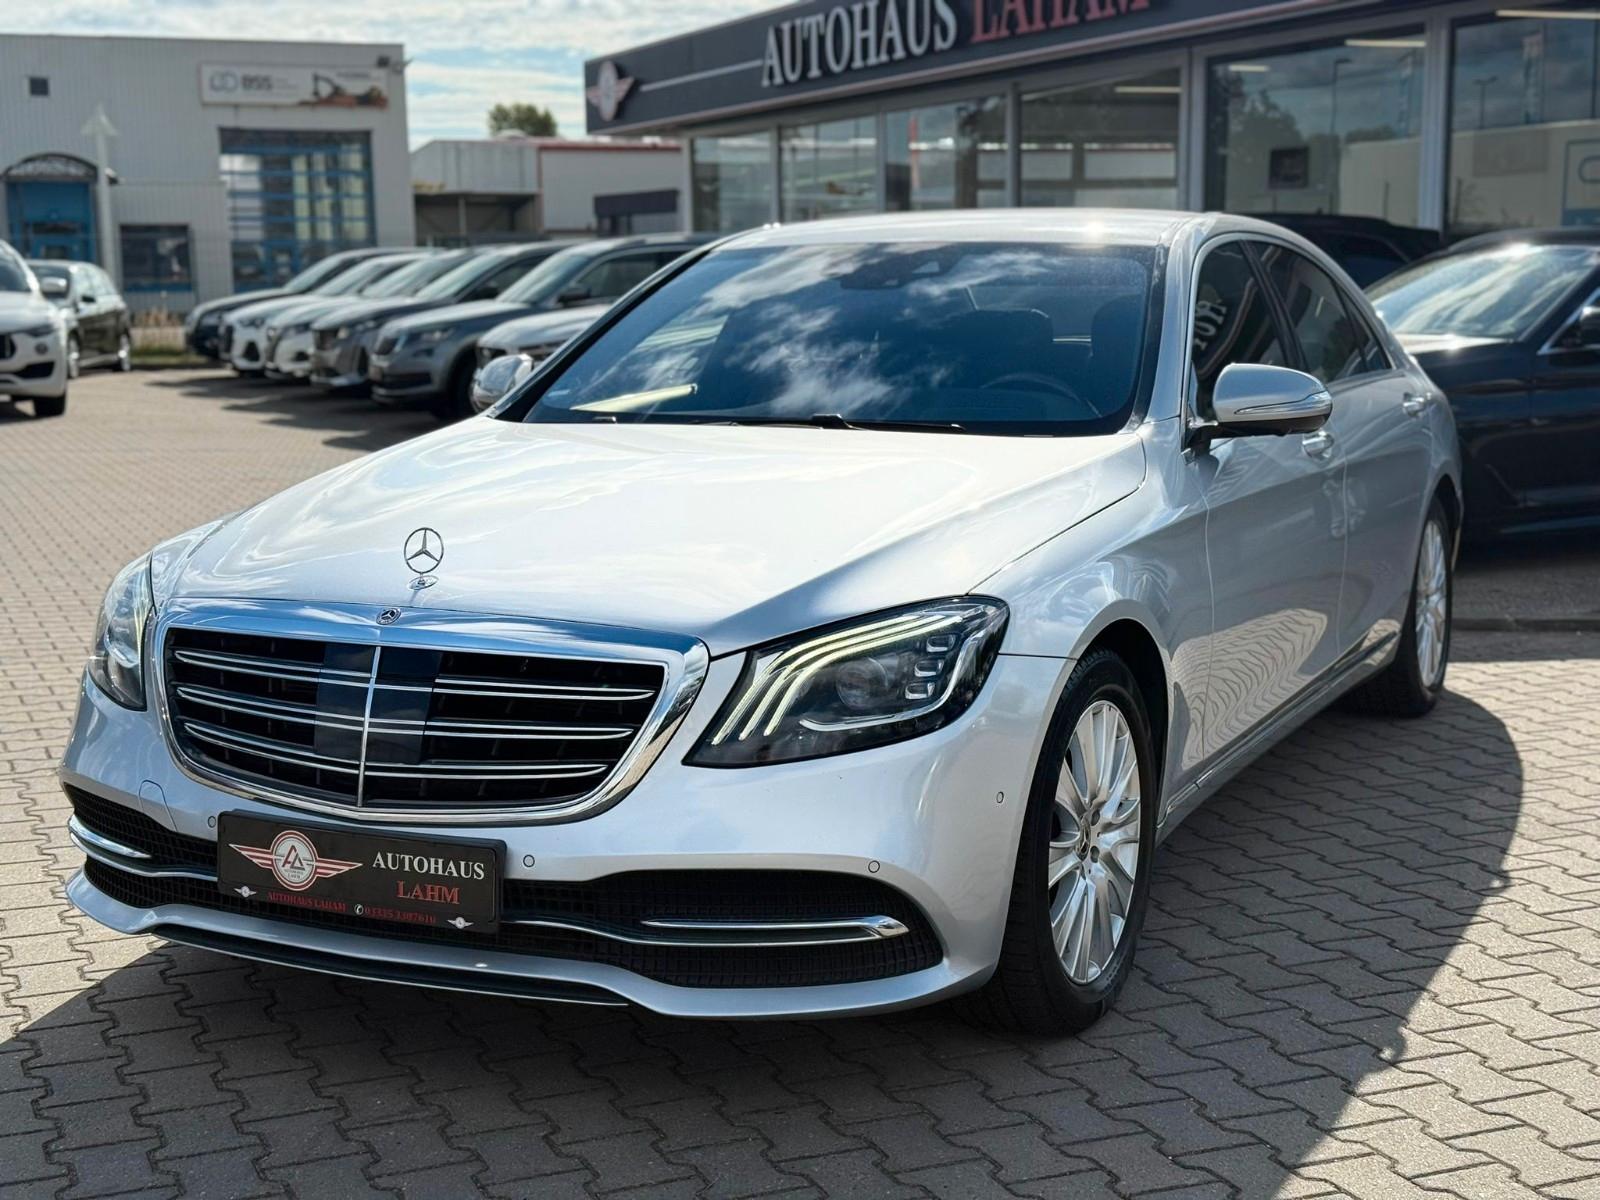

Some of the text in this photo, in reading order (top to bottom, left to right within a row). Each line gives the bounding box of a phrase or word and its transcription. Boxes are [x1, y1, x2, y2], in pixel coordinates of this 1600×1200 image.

[761, 0, 957, 87] AUTOHAUS
[372, 851, 485, 880] AUTOHAUS
[395, 880, 460, 905] LAHM
